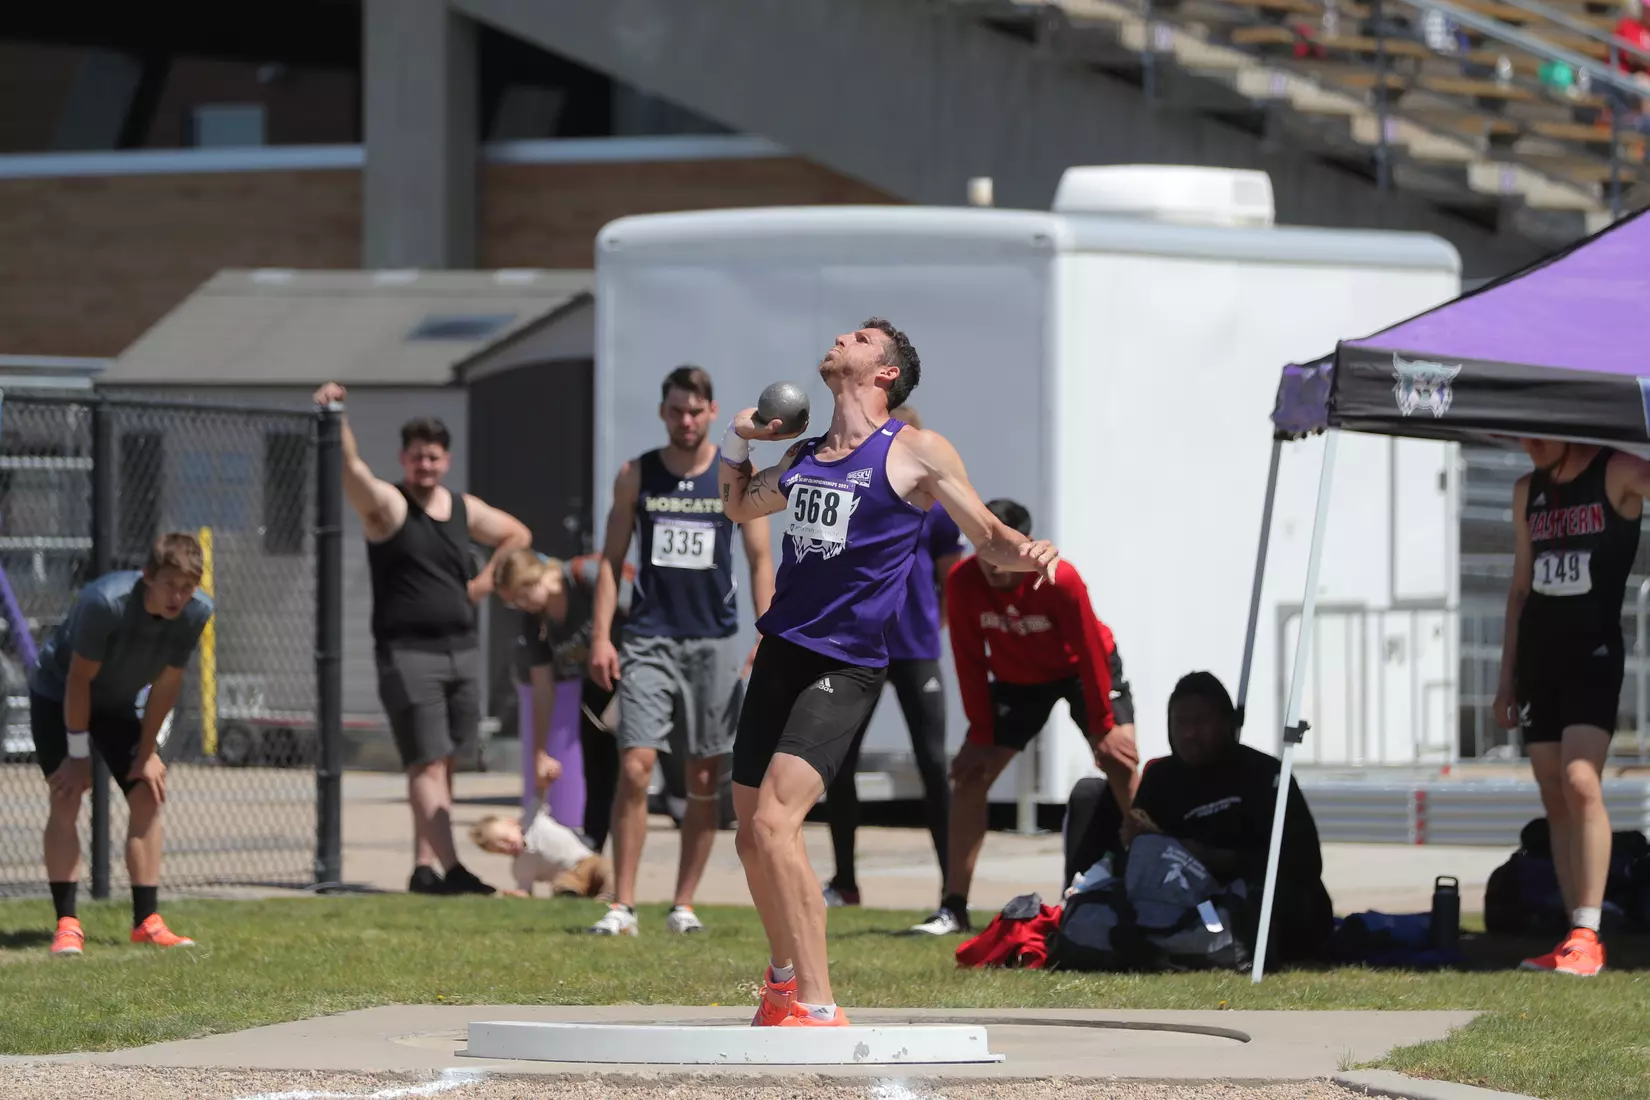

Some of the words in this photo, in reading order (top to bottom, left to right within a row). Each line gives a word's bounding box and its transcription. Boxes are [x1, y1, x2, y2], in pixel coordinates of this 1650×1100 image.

[794, 487, 840, 527] 568
[1529, 503, 1605, 541] EASTERN
[663, 529, 703, 556] 335
[1542, 554, 1580, 585] 149
